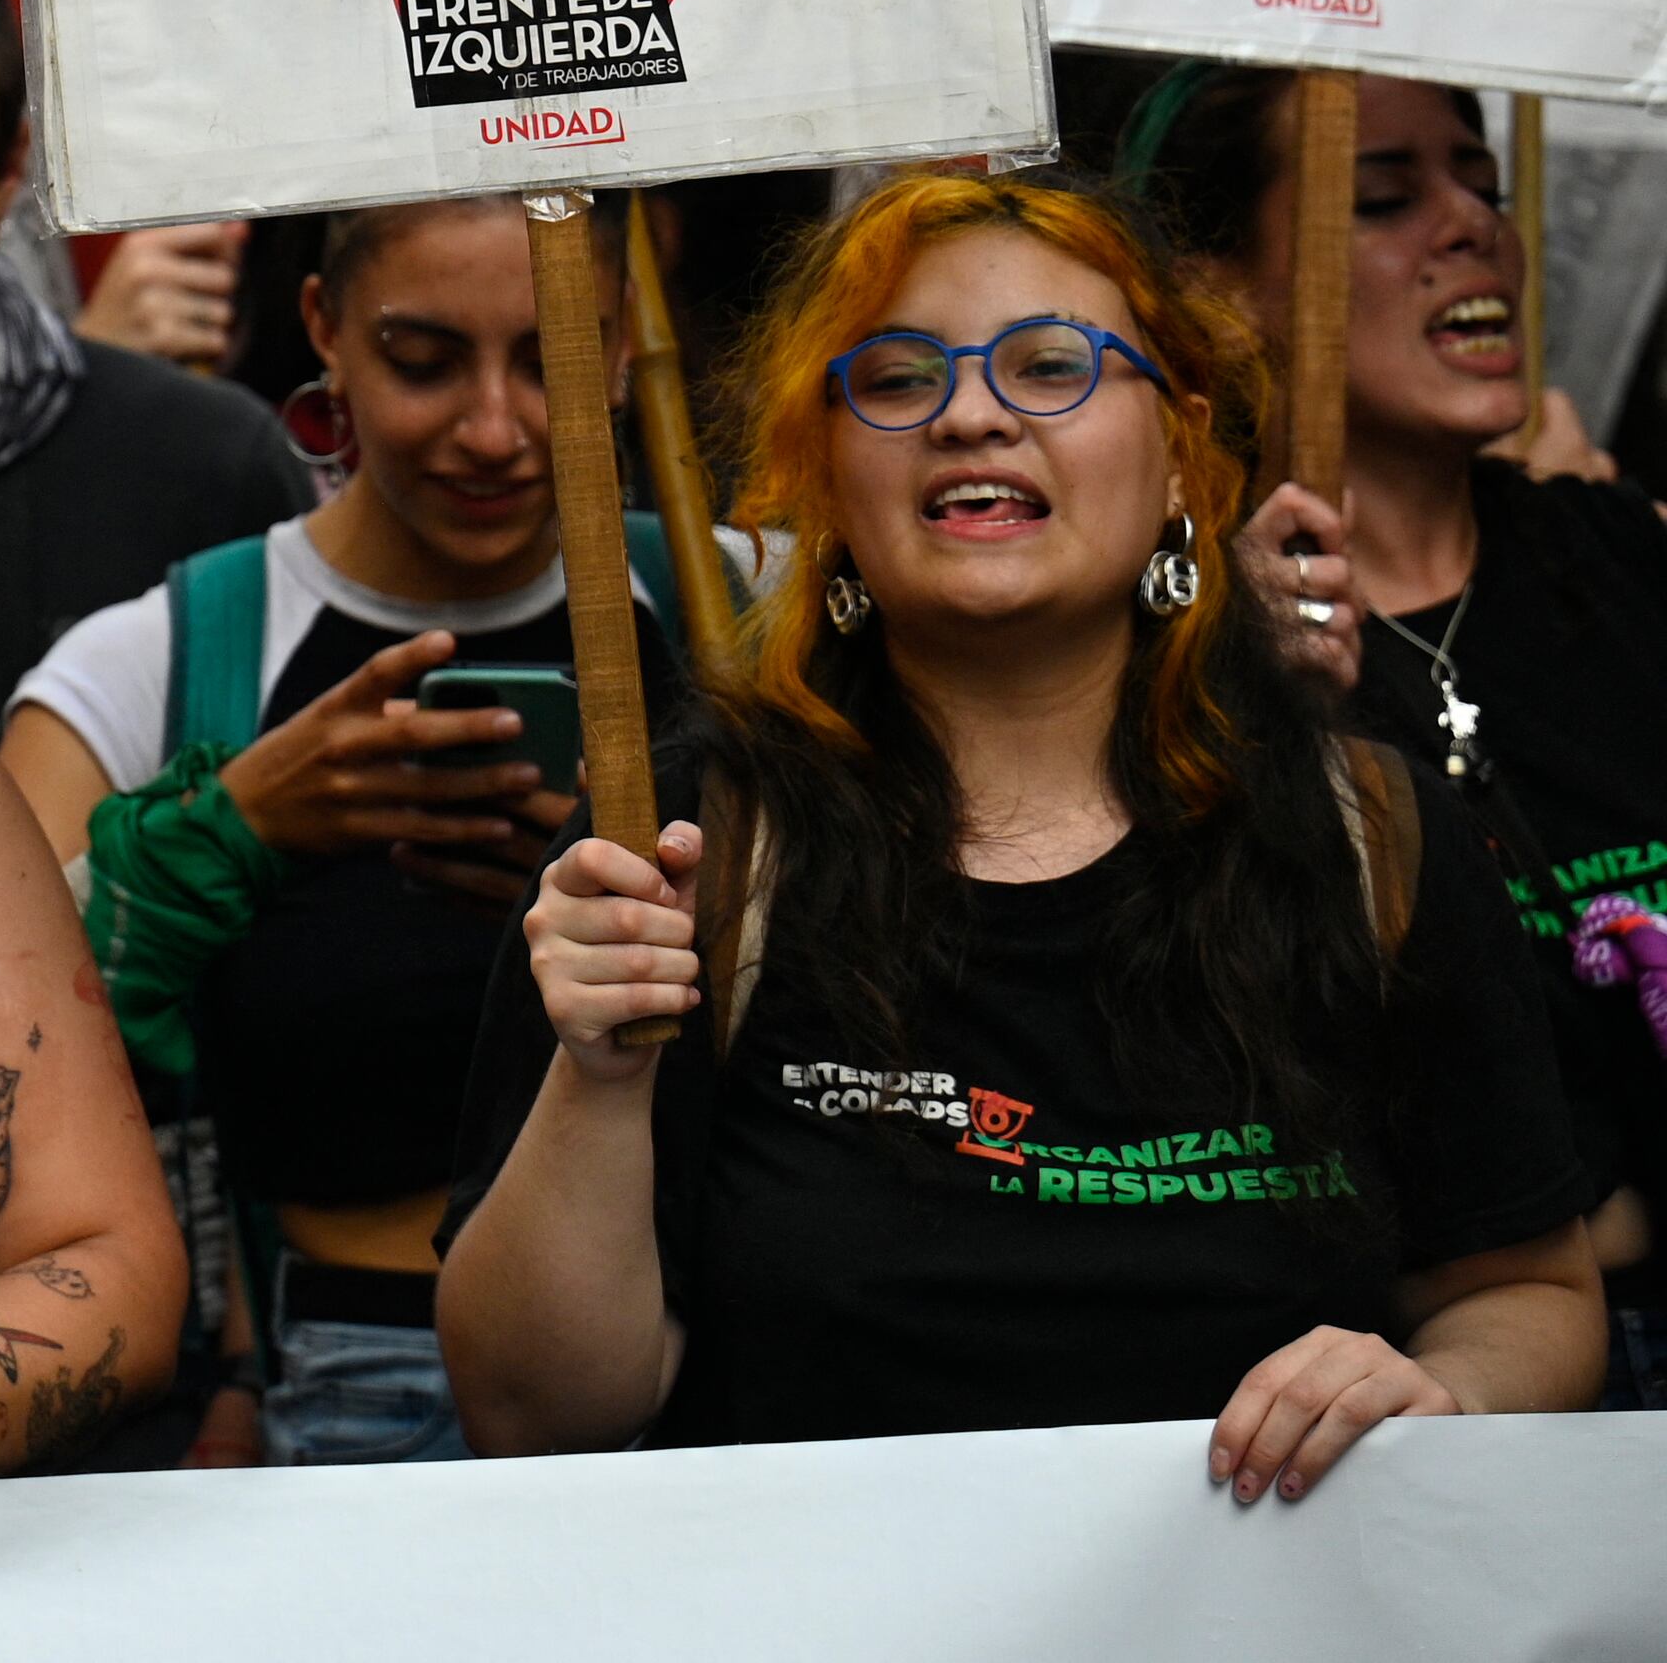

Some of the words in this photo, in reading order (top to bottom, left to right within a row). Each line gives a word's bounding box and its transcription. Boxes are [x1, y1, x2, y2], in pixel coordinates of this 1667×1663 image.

[410, 12, 674, 77] IZQUIERDA
[498, 74, 509, 90] Y
[516, 71, 539, 88] DE
[543, 57, 679, 86] TRABAJADORES
[480, 107, 613, 144] UNIDAD
[783, 1062, 955, 1095] ENTENDER
[990, 1175, 1024, 1194] LA
[1038, 1150, 1358, 1205] RESPUESTA
